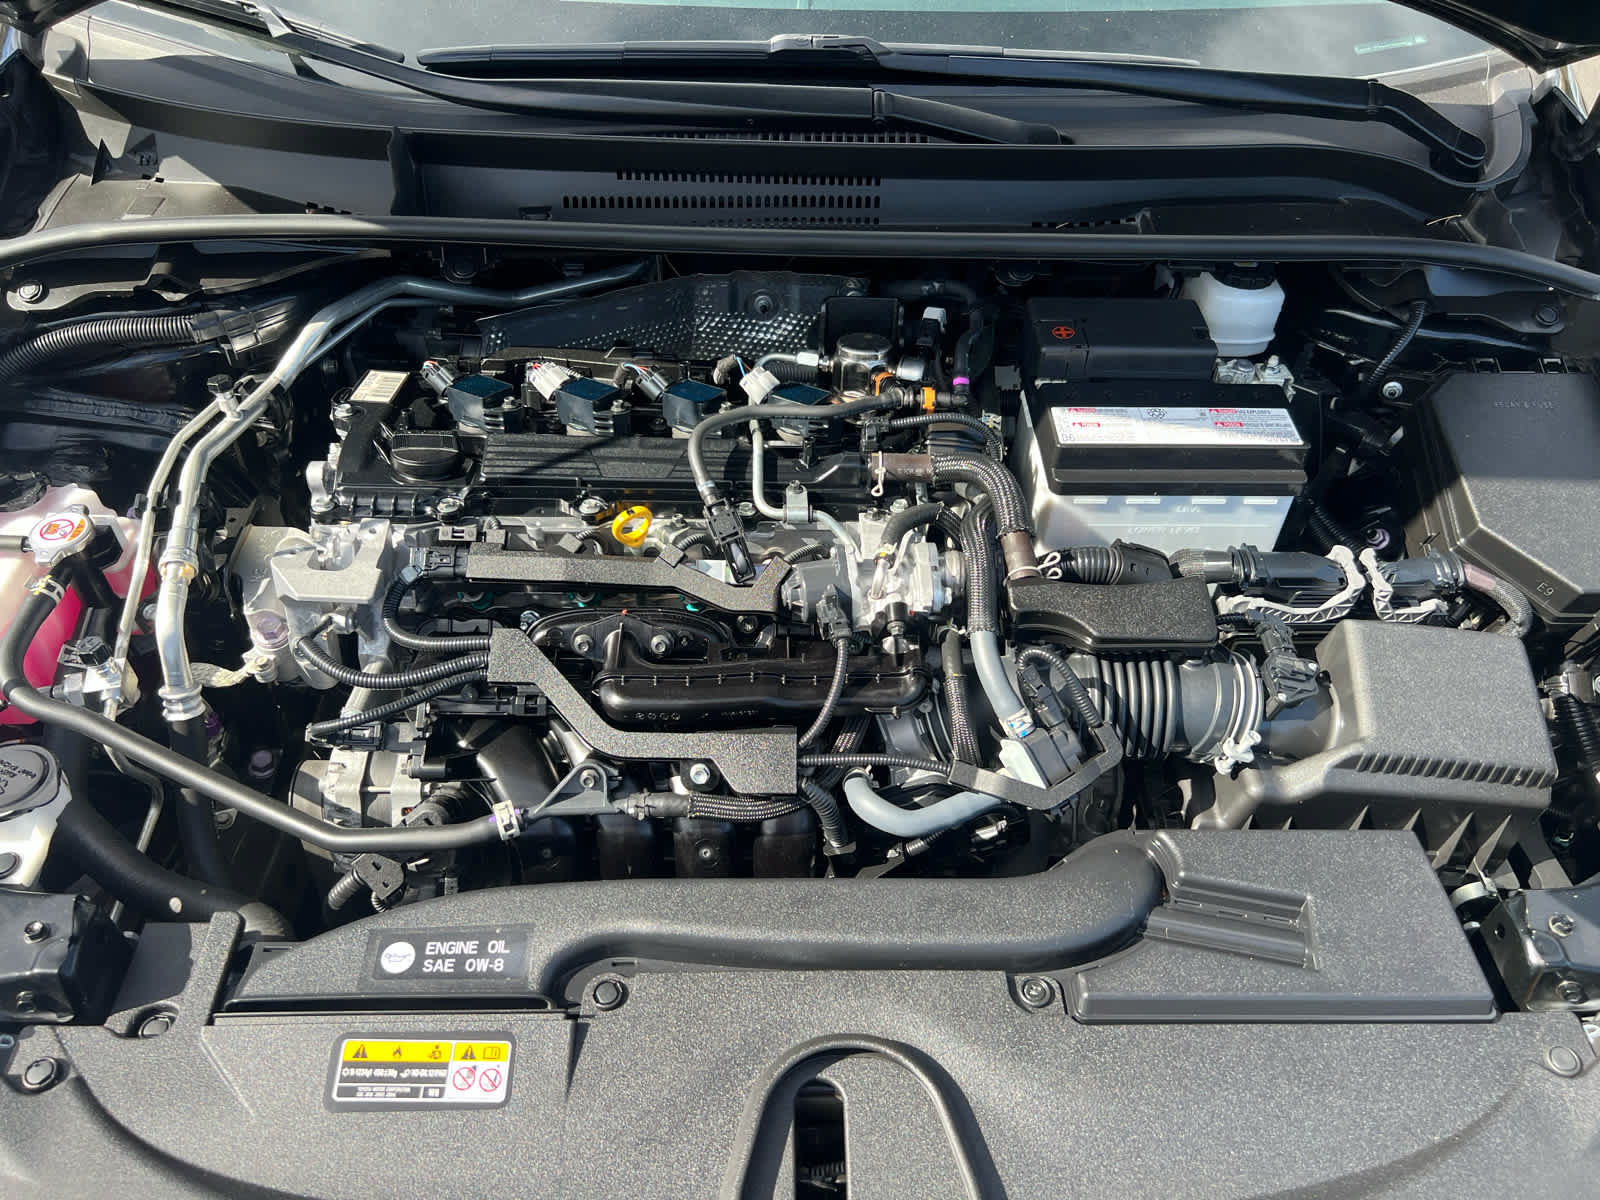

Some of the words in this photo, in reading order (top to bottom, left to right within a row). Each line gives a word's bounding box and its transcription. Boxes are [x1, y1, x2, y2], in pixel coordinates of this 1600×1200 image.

[425, 940, 479, 955] ENGINE
[487, 940, 510, 954] OIL
[422, 958, 456, 973] SAE
